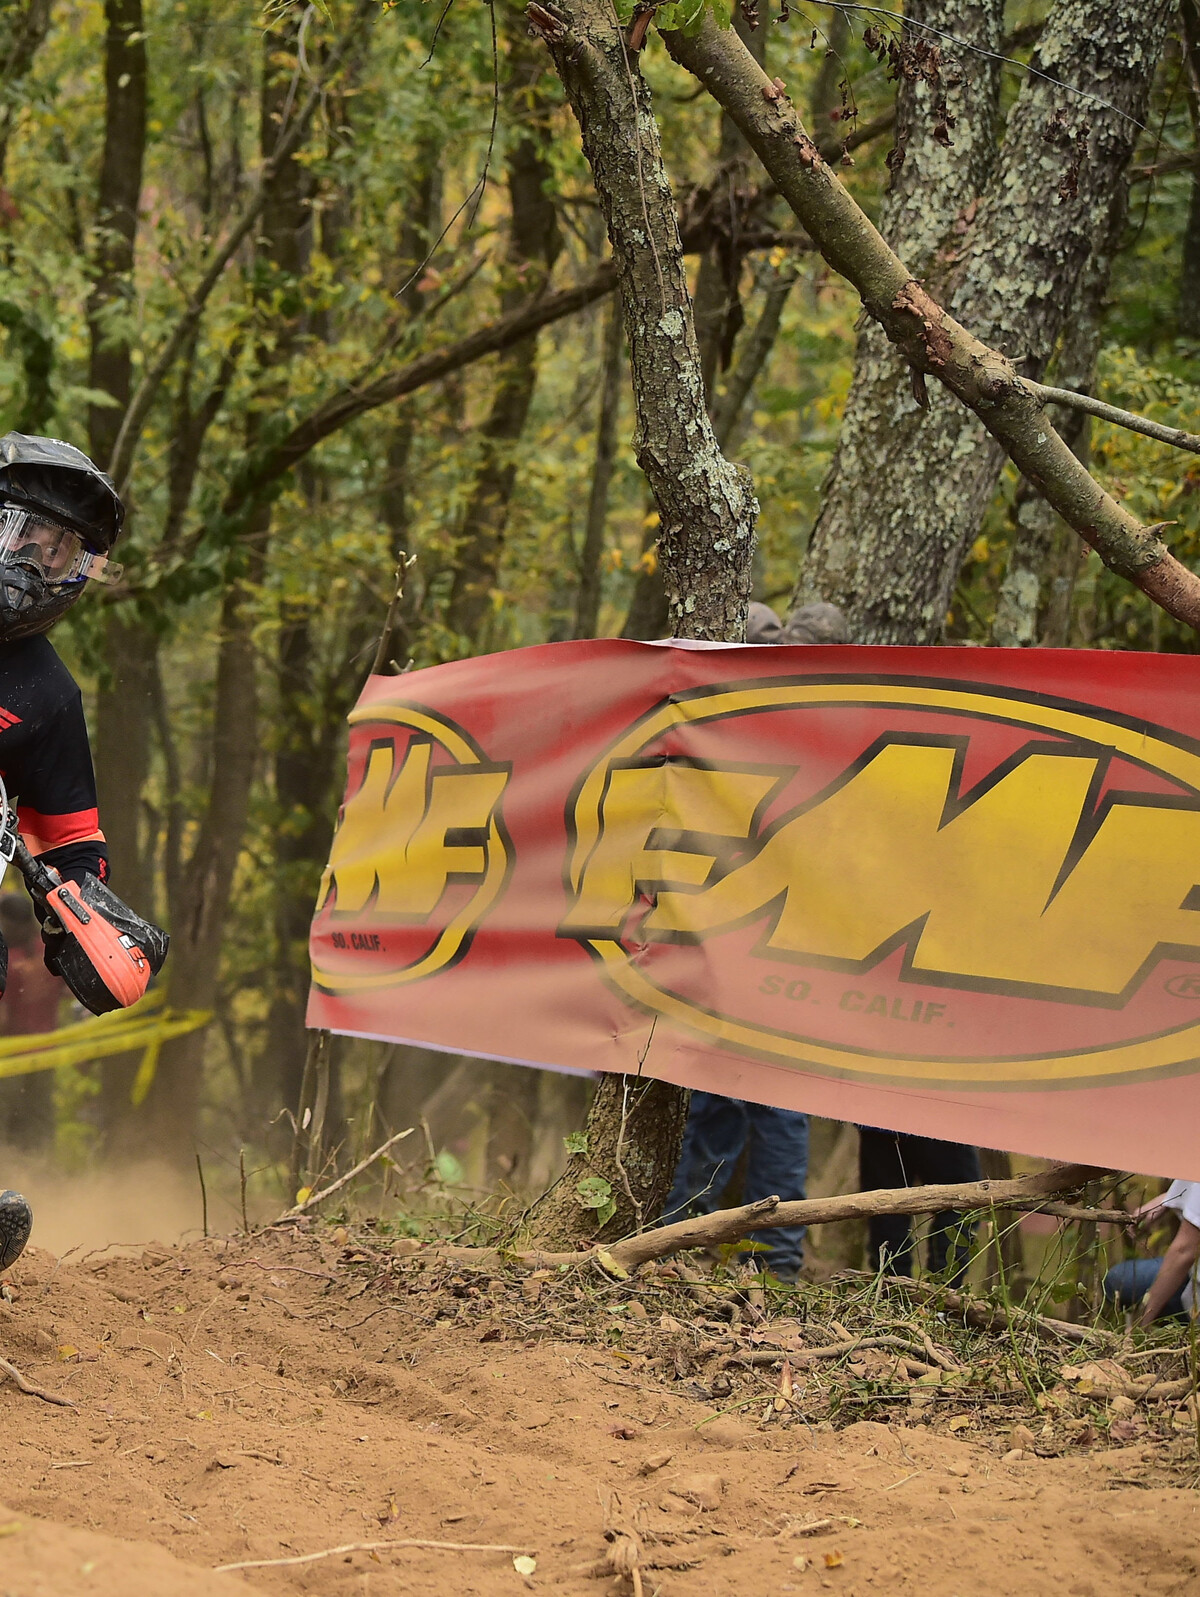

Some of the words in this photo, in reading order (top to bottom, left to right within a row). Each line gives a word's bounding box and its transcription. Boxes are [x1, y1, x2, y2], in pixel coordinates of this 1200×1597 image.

[315, 732, 514, 925] MF
[352, 933, 387, 952] CALIF.
[758, 974, 818, 1005] SO.
[837, 989, 956, 1029] CALIF.
